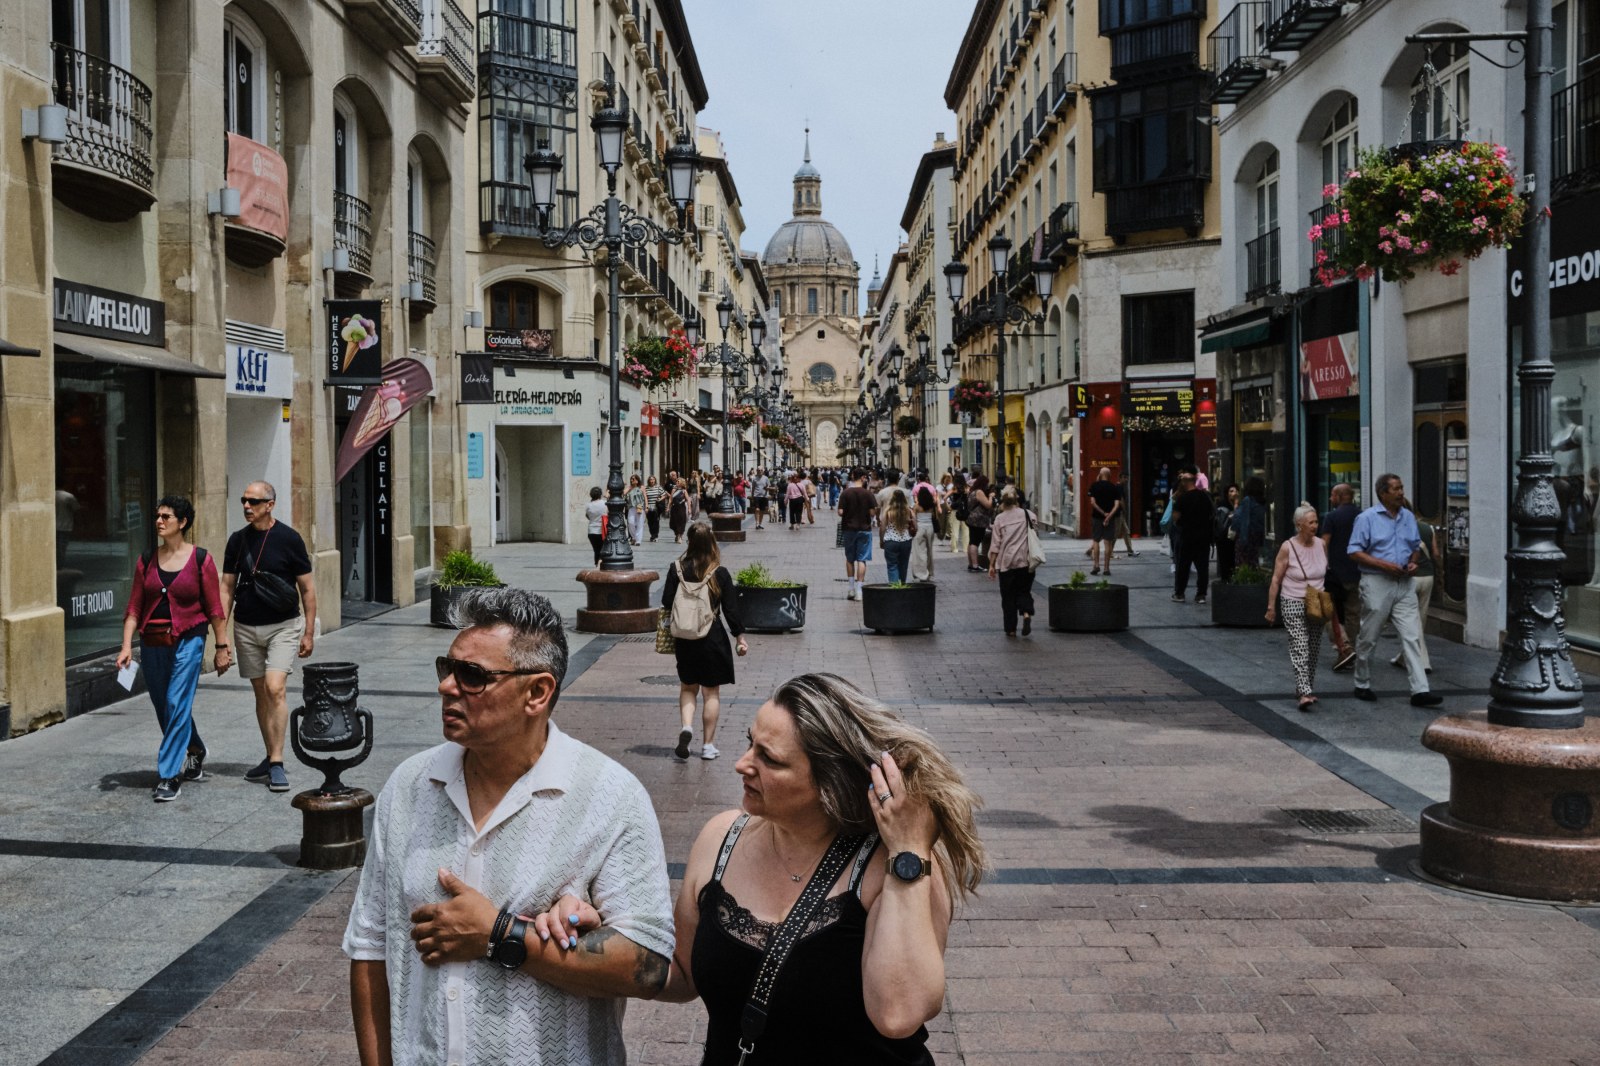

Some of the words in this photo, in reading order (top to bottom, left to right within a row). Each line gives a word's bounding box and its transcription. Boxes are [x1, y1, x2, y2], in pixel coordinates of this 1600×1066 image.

[331, 315, 339, 371] HELADOS
[1315, 364, 1345, 382] ARESSO
[494, 387, 582, 406] ELERÍA-HELADERÍA
[377, 445, 387, 535] GELATI
[71, 595, 87, 617] THE
[87, 590, 114, 615] ROUND
